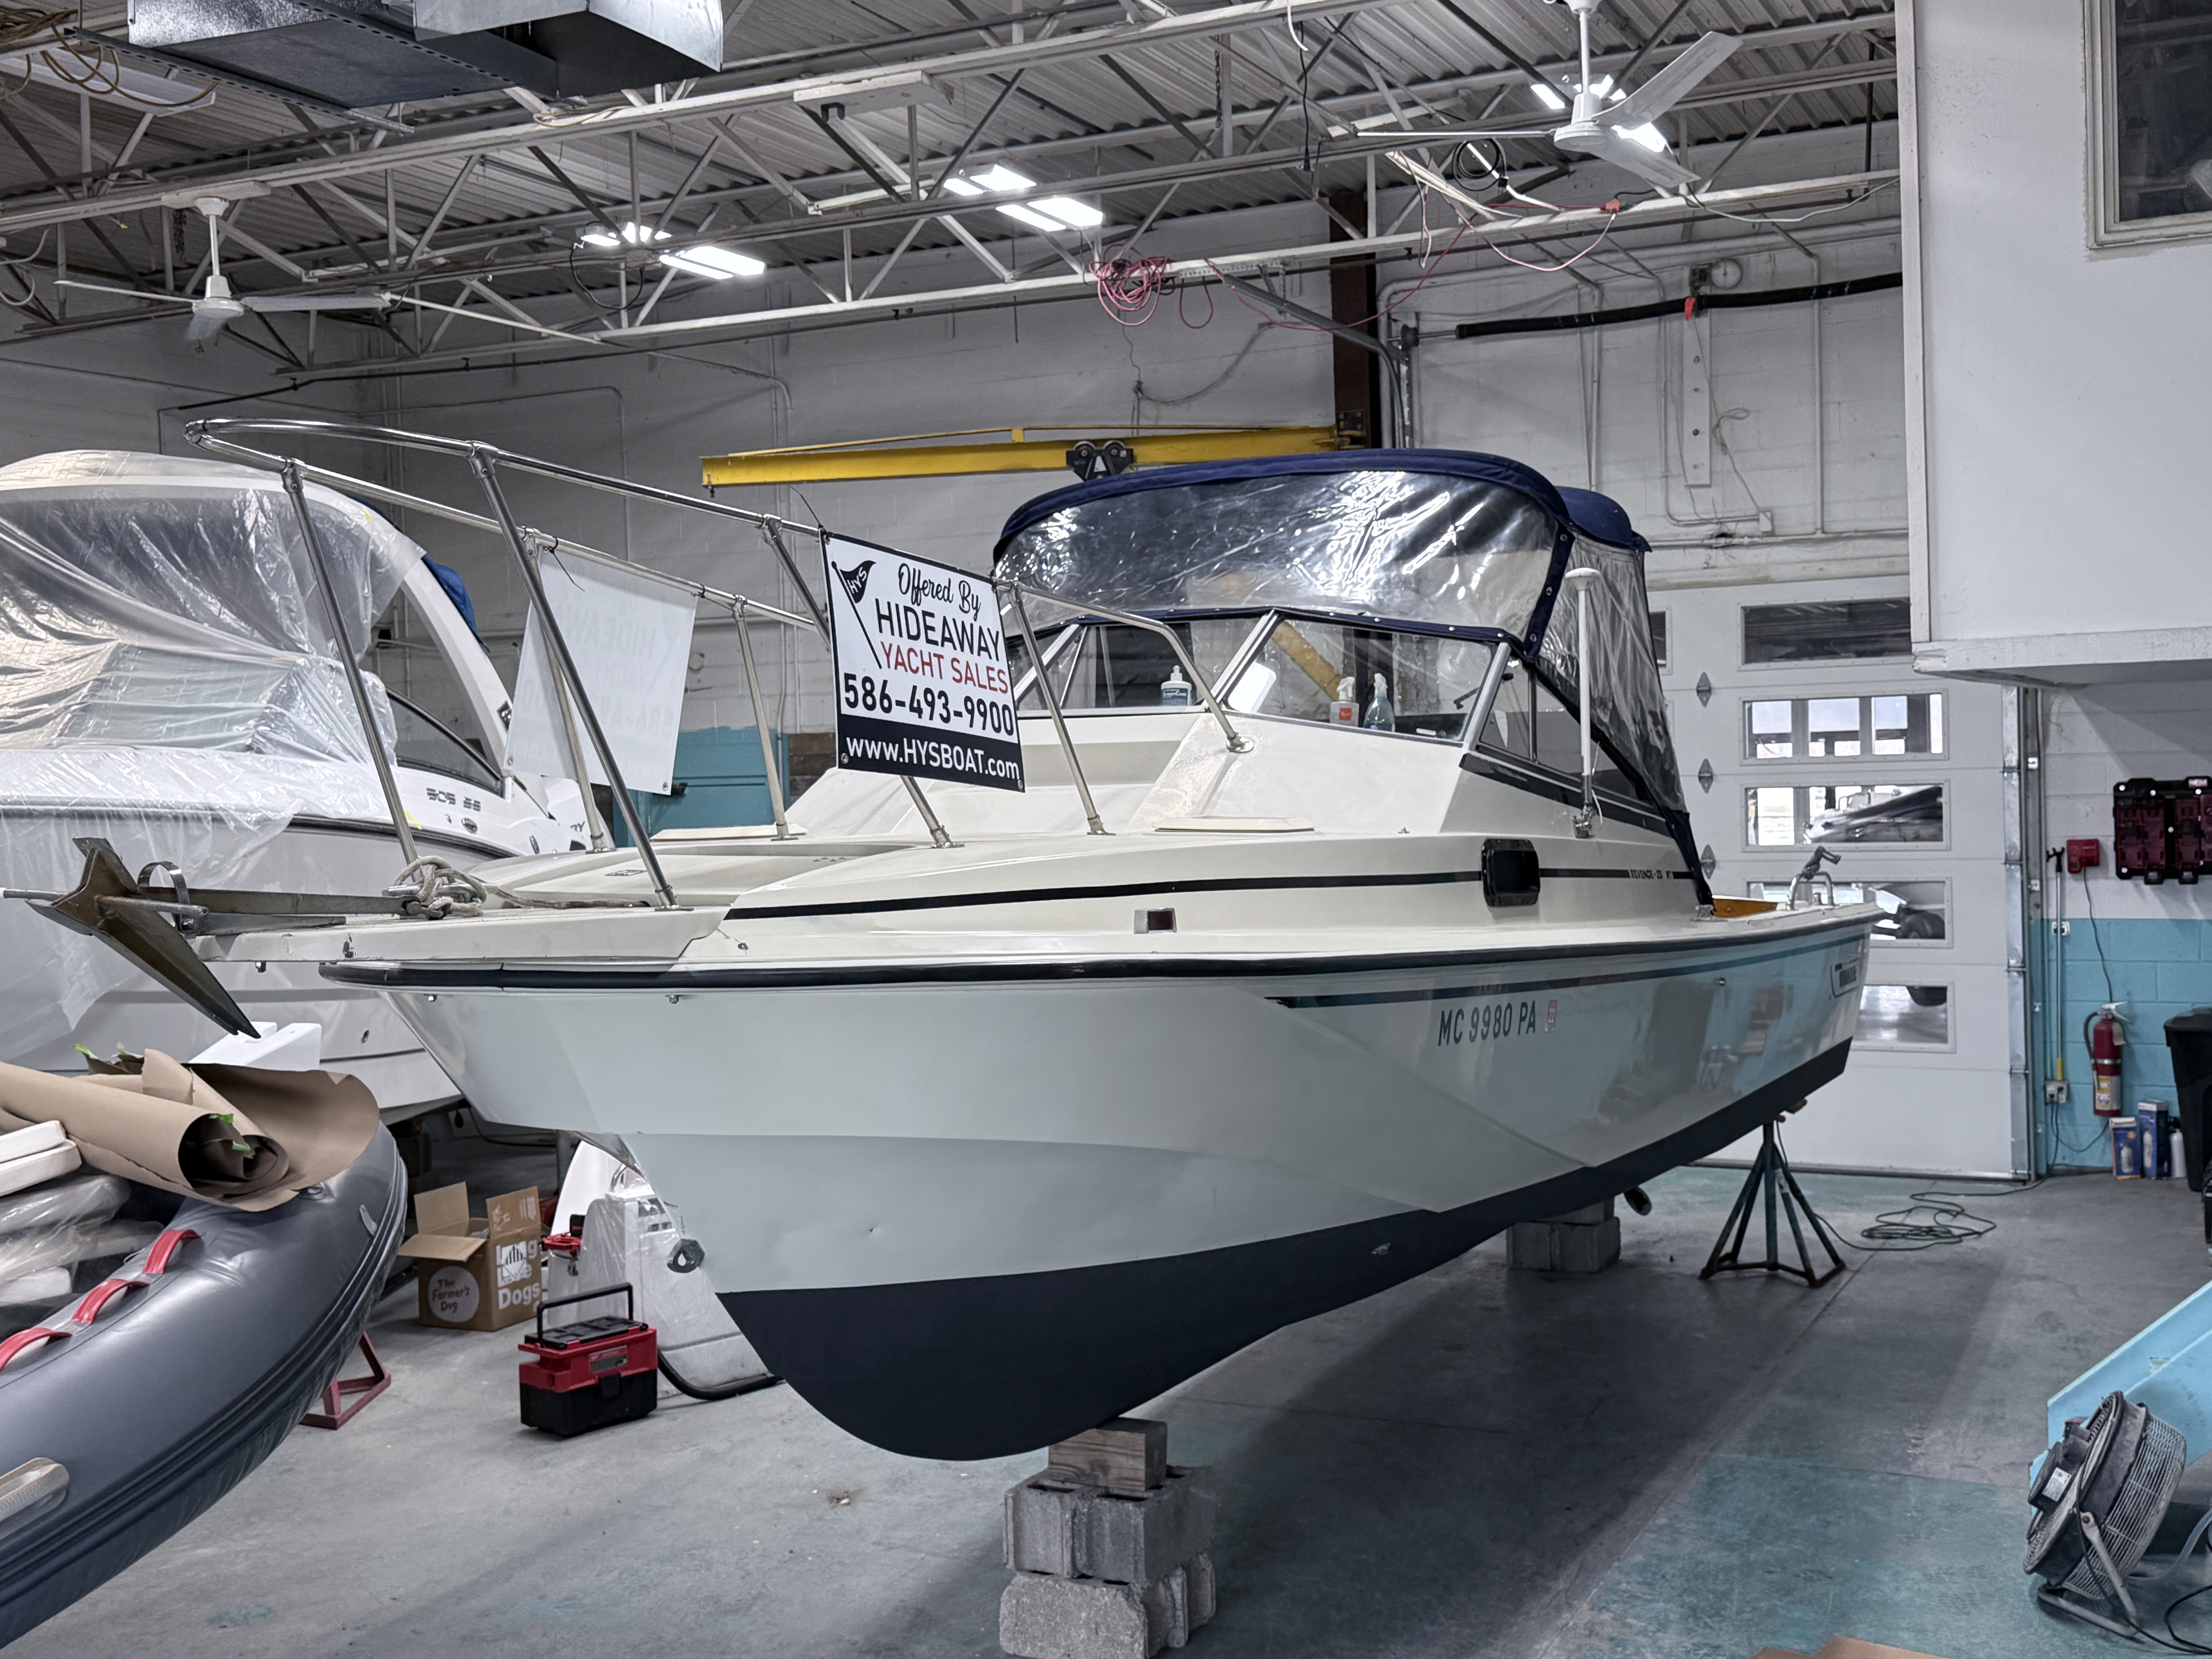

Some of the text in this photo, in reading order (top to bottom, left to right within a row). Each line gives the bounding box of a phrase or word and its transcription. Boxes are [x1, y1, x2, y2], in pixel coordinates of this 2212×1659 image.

[847, 566, 867, 594] HYS
[898, 563, 982, 622] Offered By
[875, 598, 1000, 661] HIDEAWAY
[880, 641, 1008, 695] YACHT SALES
[843, 672, 1015, 736] 586-493-9900
[846, 737, 1020, 780] www.HYSBOAT.com
[1437, 1000, 1536, 1046] MC 9980 PA
[498, 1282, 540, 1310] Dogs
